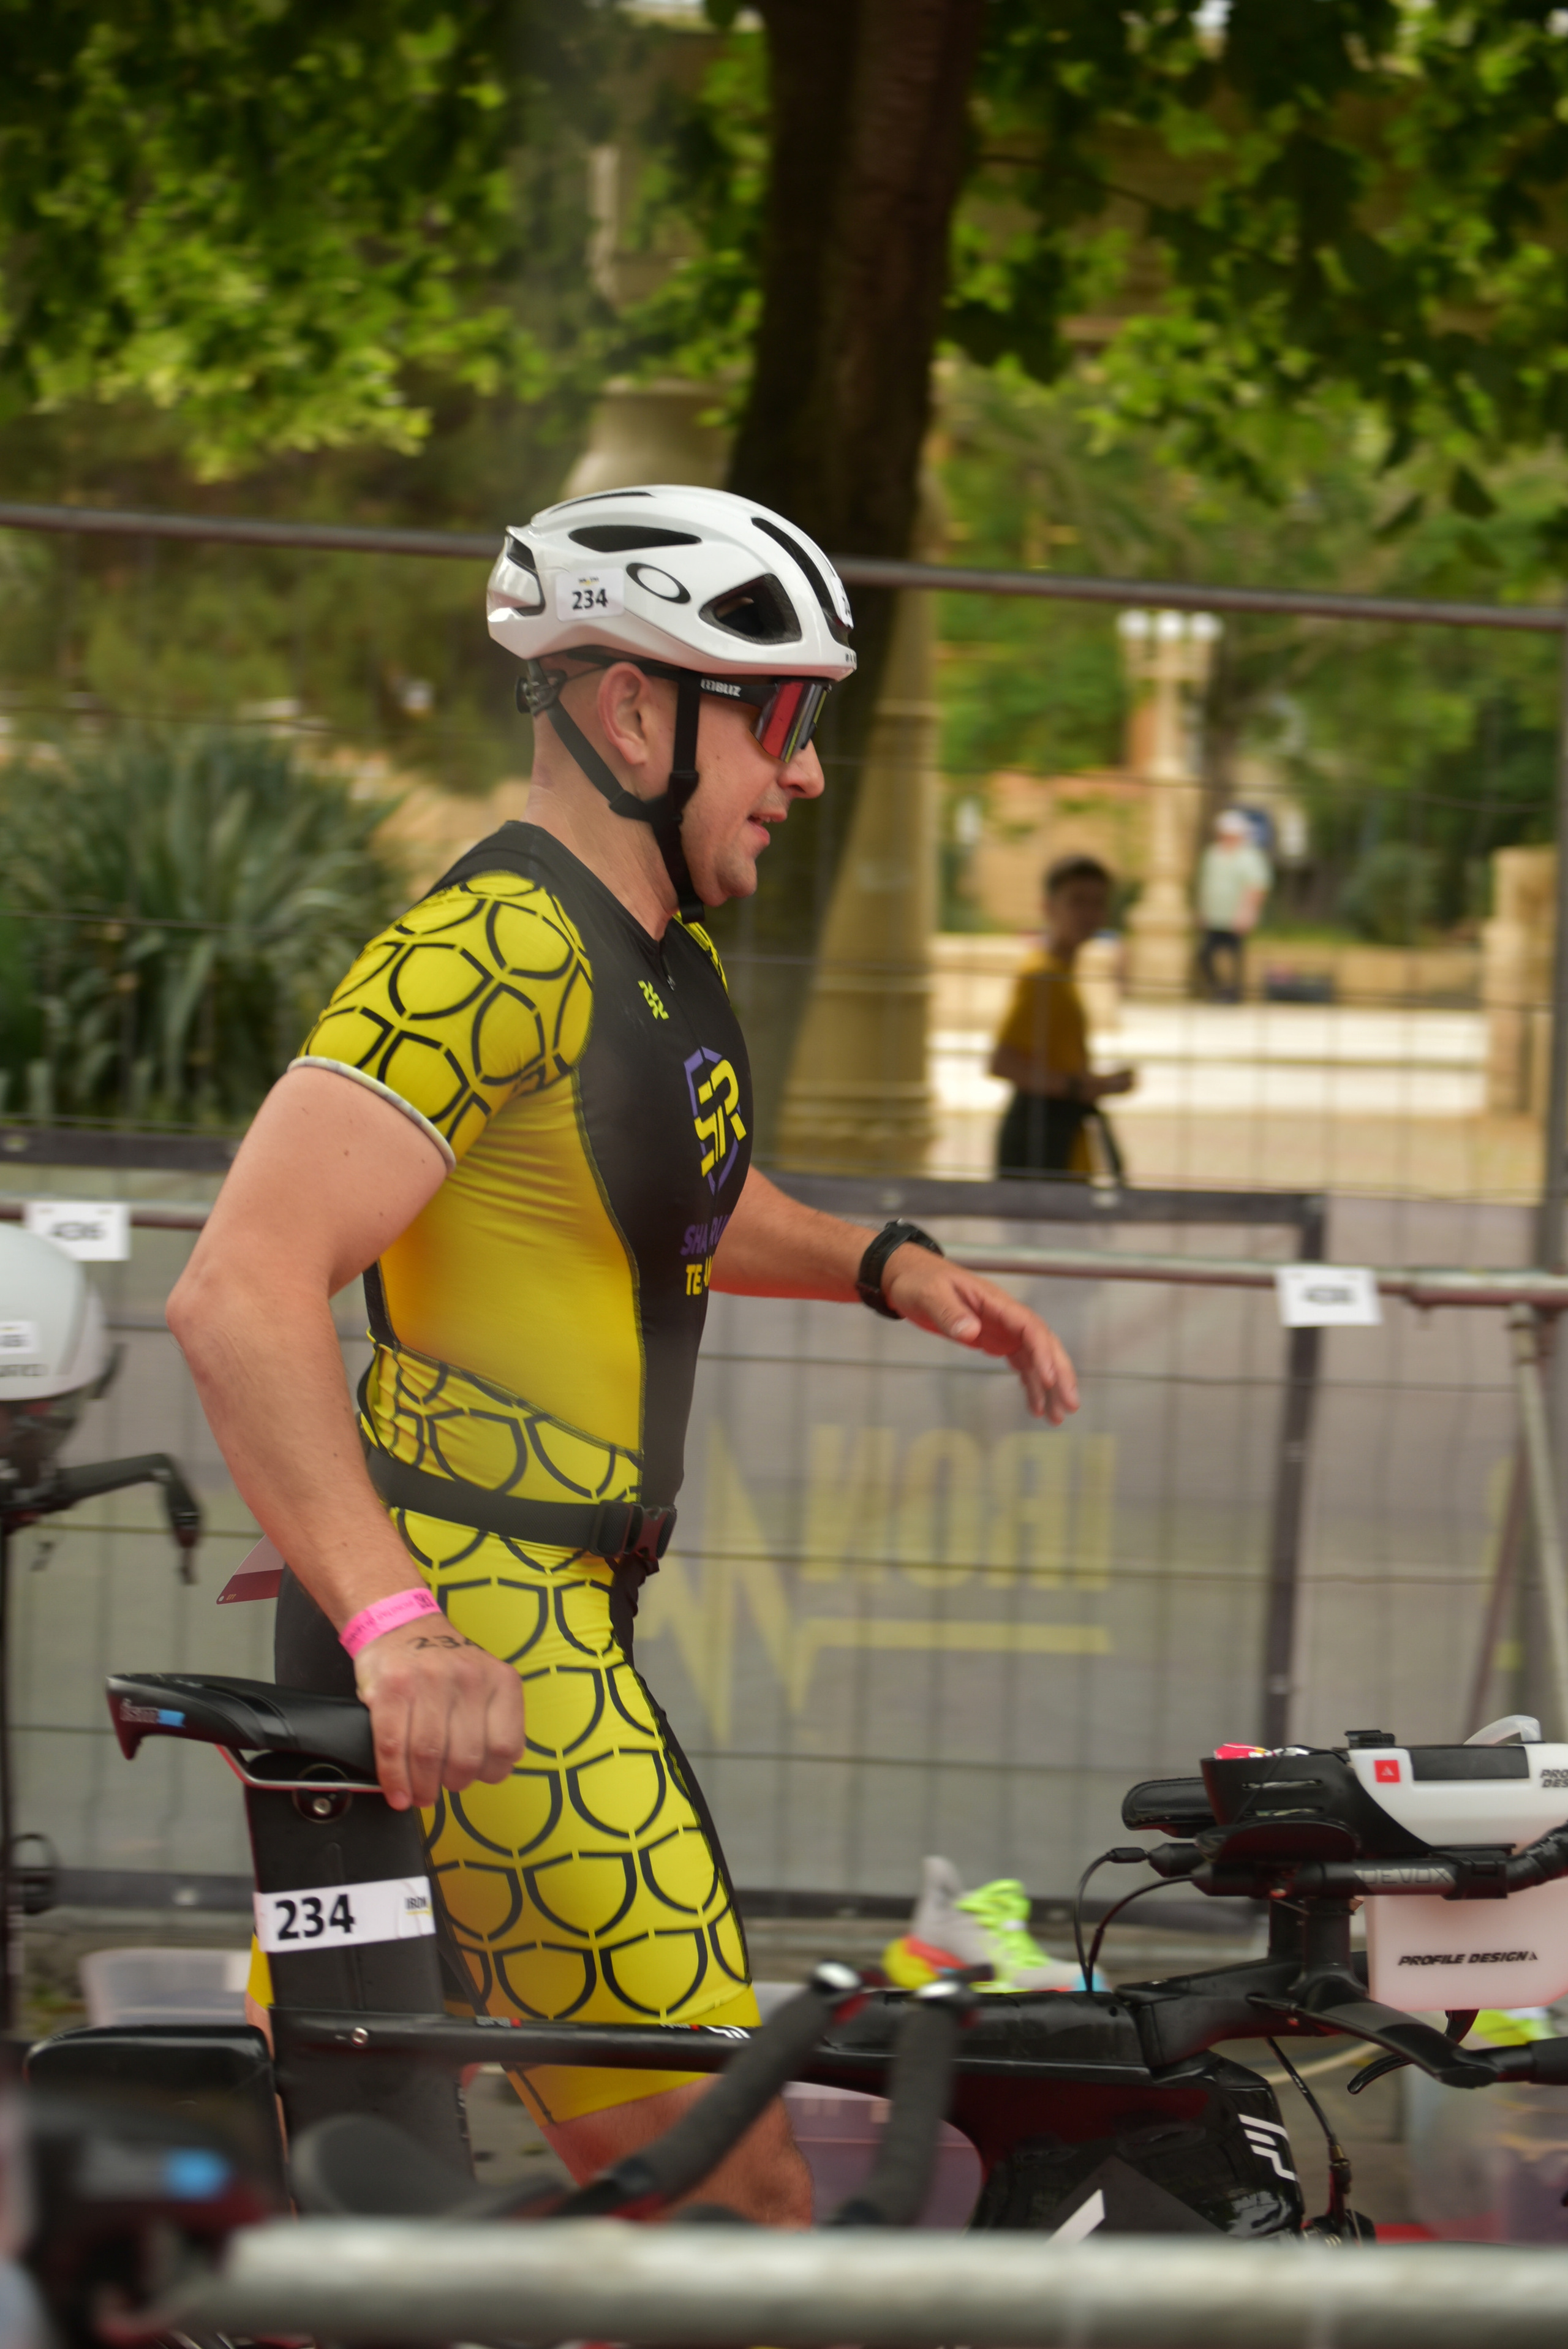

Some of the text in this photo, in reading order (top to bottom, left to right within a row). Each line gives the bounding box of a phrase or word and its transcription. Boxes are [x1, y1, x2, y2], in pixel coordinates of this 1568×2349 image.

[572, 589, 608, 610] 234
[275, 1894, 355, 1940] 234
[1398, 1951, 1529, 1966] PROFILE DESIGN
